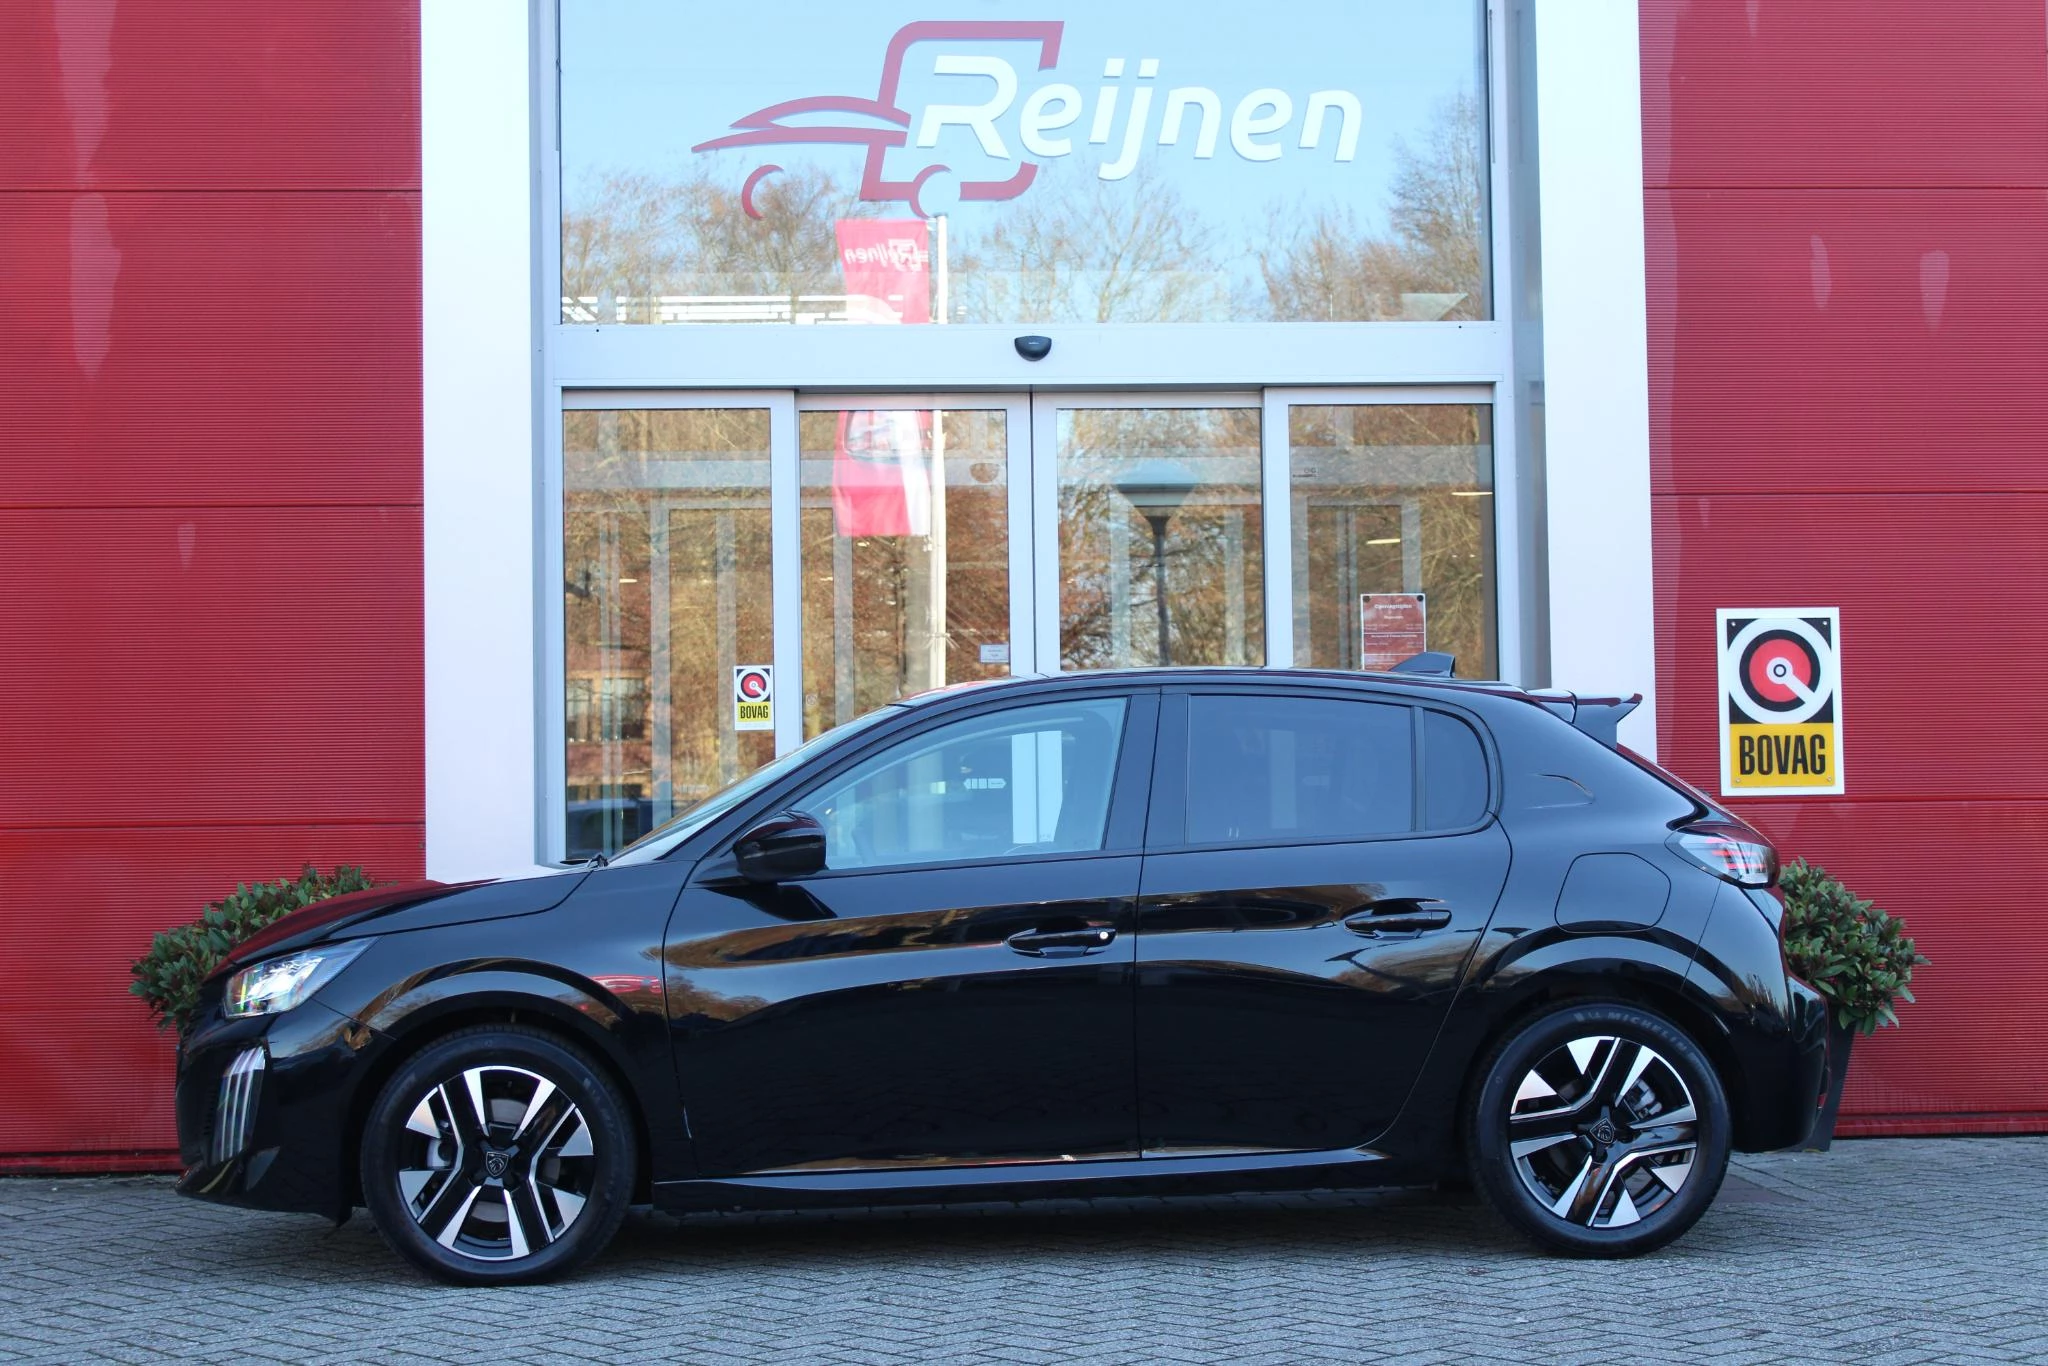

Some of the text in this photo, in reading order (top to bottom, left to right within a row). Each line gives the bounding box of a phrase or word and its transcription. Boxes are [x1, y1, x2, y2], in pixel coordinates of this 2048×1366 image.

[916, 55, 1362, 181] Reijnen
[740, 705, 769, 719] BOVAG
[1738, 734, 1826, 776] BOVAG
[1607, 1011, 1688, 1053] MICHELIN
